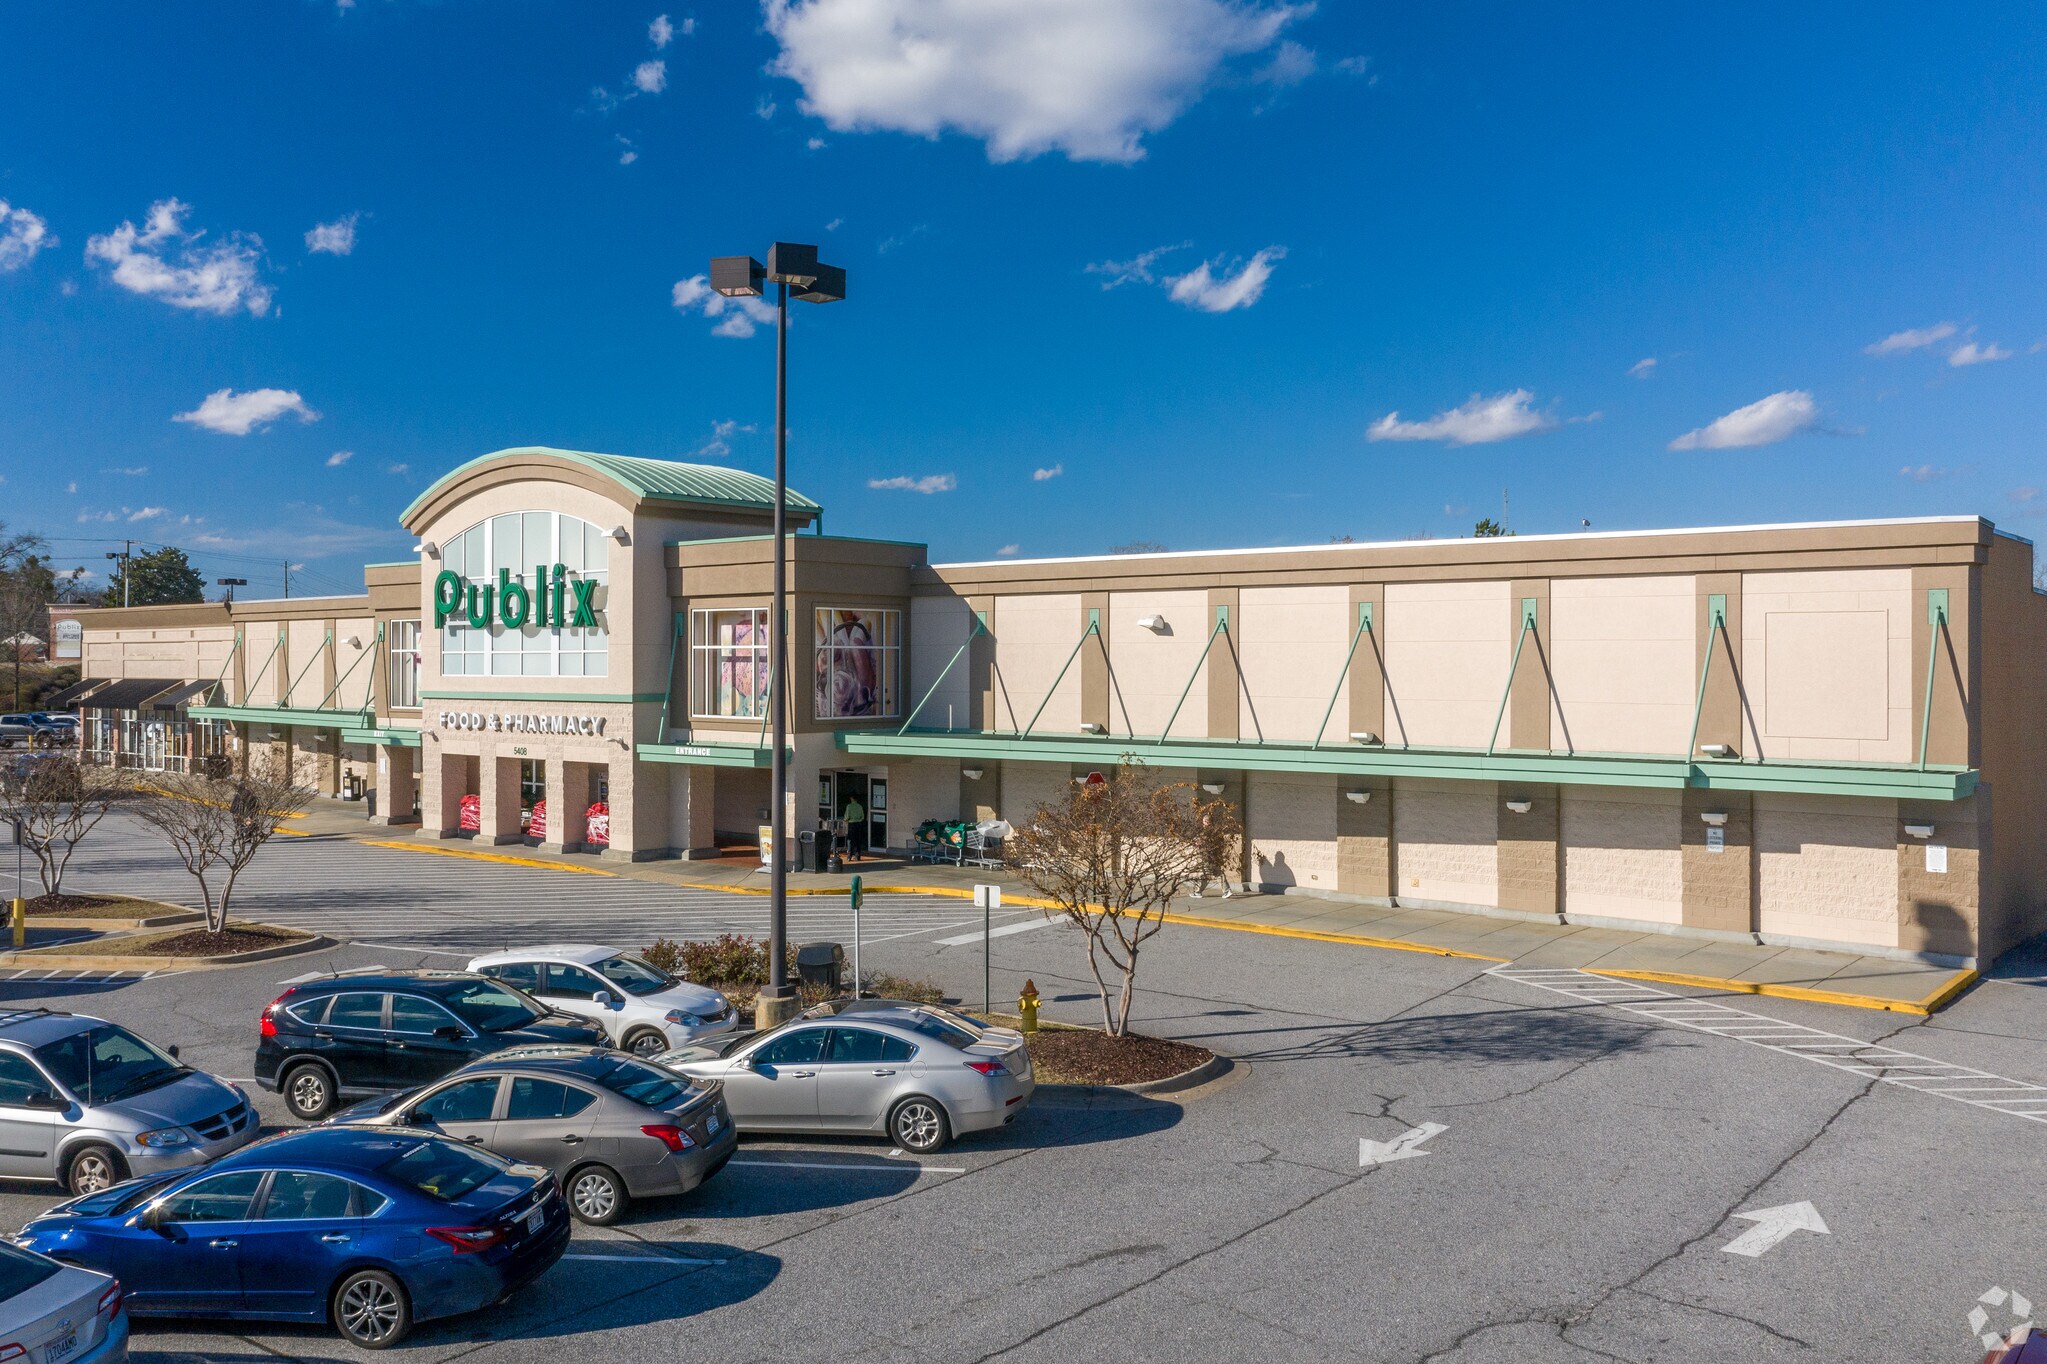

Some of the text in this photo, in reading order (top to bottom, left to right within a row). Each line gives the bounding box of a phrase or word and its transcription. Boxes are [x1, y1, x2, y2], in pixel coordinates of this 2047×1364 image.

[434, 563, 598, 629] Publix
[440, 711, 603, 735] FOOD & PHARMACY
[513, 746, 528, 756] 5408
[675, 746, 711, 756] ENTRANCE
